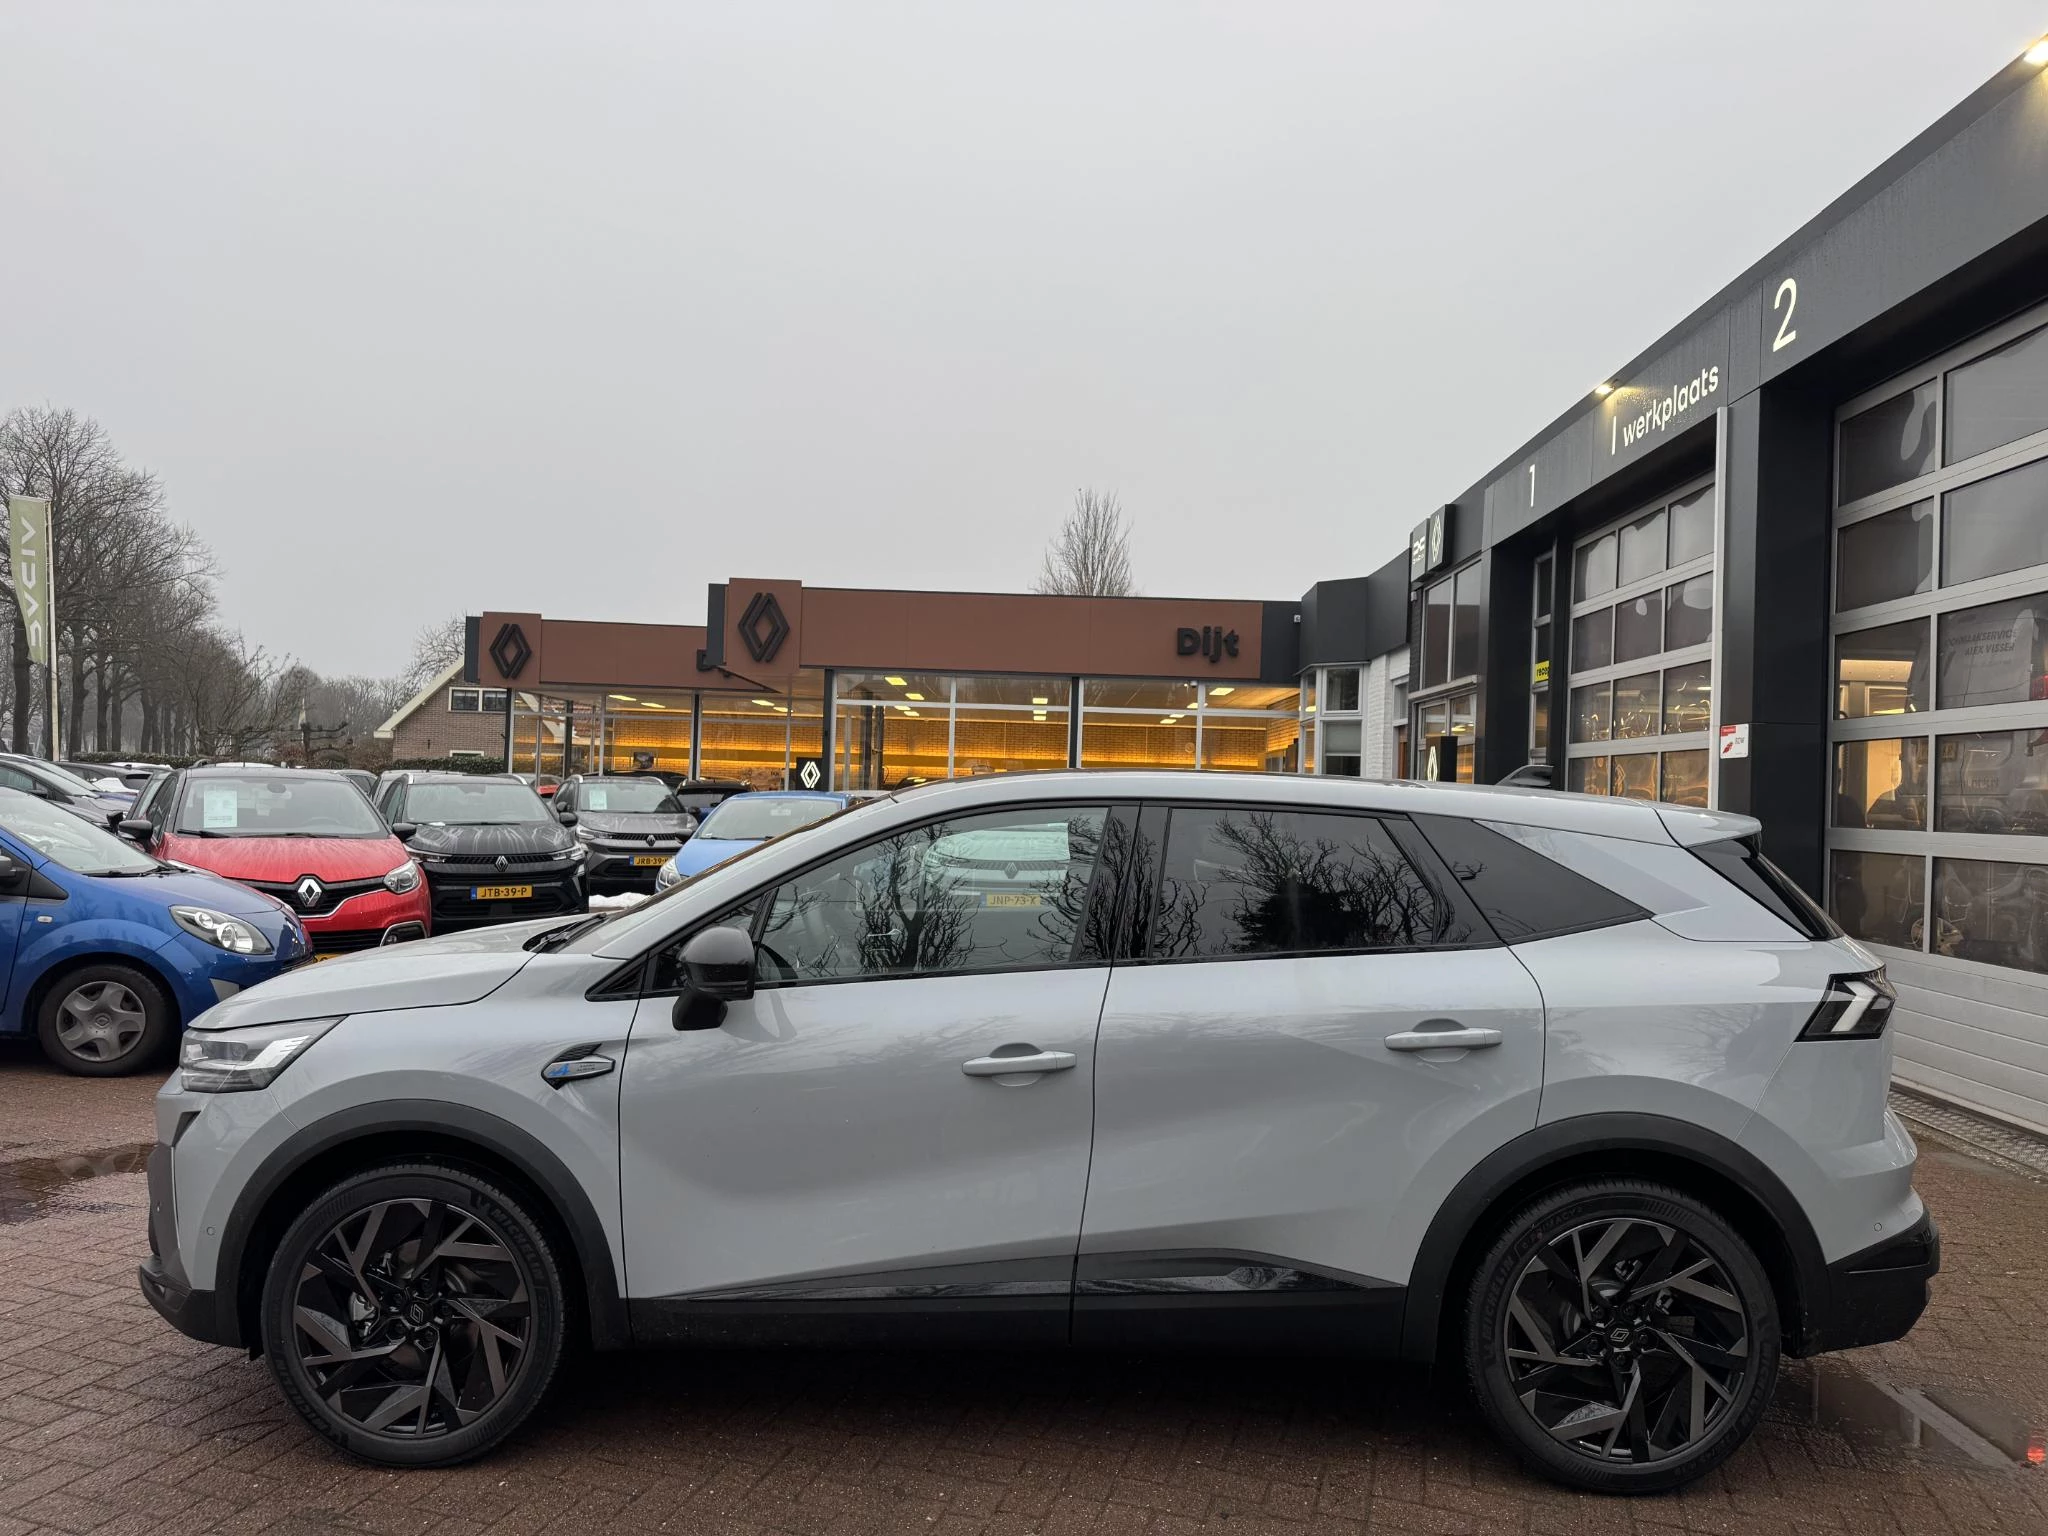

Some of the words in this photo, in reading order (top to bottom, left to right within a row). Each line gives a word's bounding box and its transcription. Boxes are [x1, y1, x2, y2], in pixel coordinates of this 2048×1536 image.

[1773, 278, 1797, 352] 2
[1623, 366, 1718, 447] werkplaats
[1529, 464, 1536, 507] 1
[1177, 626, 1239, 663] Dijt
[480, 886, 528, 898] JTB-39-P
[990, 895, 1036, 905] JNP-73-X
[491, 1208, 546, 1281] MICHELIN
[1482, 1255, 1516, 1340] MICHELIN
[275, 1359, 330, 1431] MICHELIN
